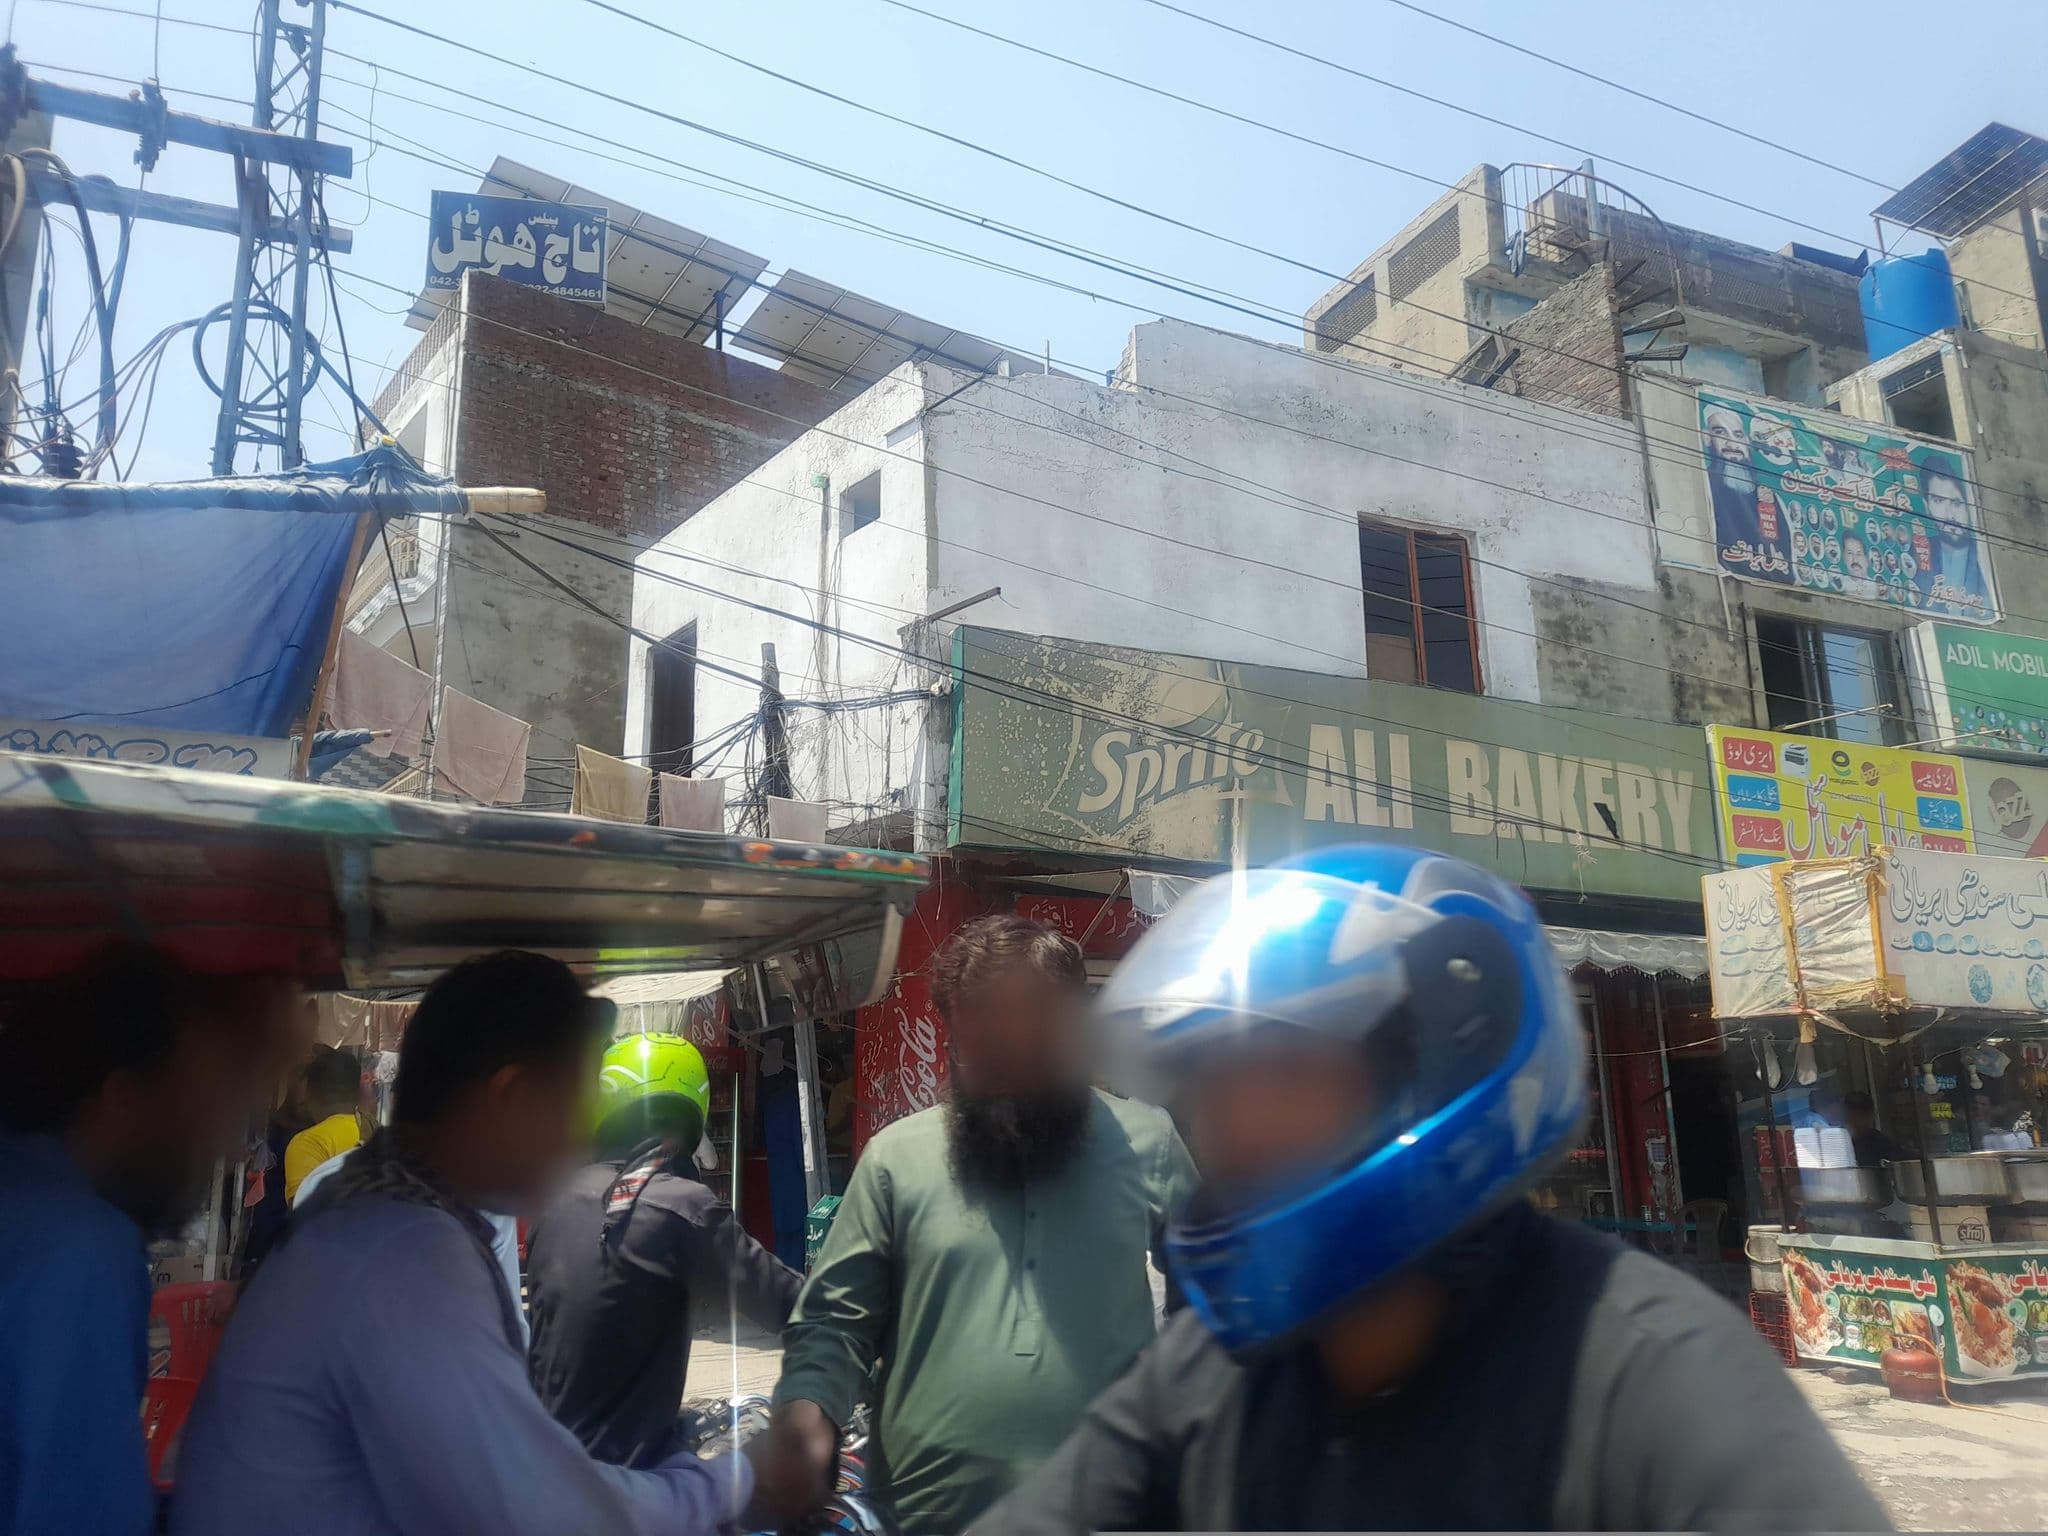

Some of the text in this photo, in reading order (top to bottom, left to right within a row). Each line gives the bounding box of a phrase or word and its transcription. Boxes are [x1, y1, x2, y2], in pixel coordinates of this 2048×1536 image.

[542, 222, 600, 284] تاج
[1946, 642, 2048, 678] ADIL MOBIL
[1077, 703, 1265, 823] Sprite
[1304, 723, 1694, 853] ALI BAKERY
[1889, 856, 1943, 926] بریانی
[1944, 868, 2007, 927] سندھی
[1825, 1259, 1867, 1293] بریانی
